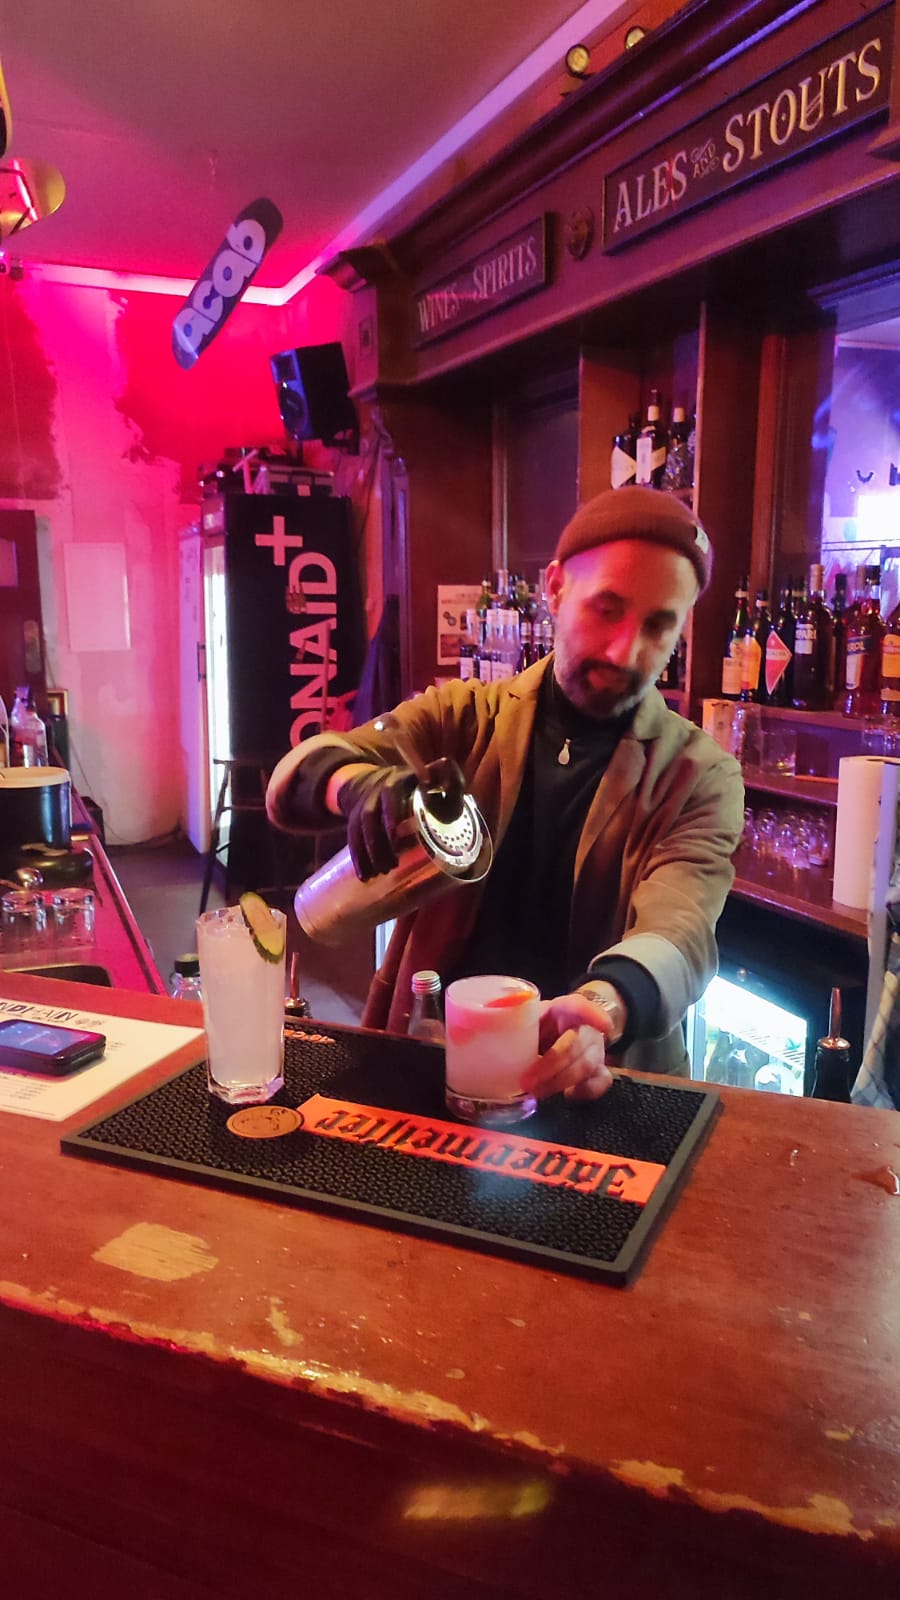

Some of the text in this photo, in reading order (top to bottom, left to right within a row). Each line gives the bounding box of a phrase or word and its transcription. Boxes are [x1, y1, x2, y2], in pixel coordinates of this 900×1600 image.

[613, 149, 688, 233] ALES
[722, 37, 881, 173] STOUTS
[418, 236, 537, 333] WINES SPIRITS
